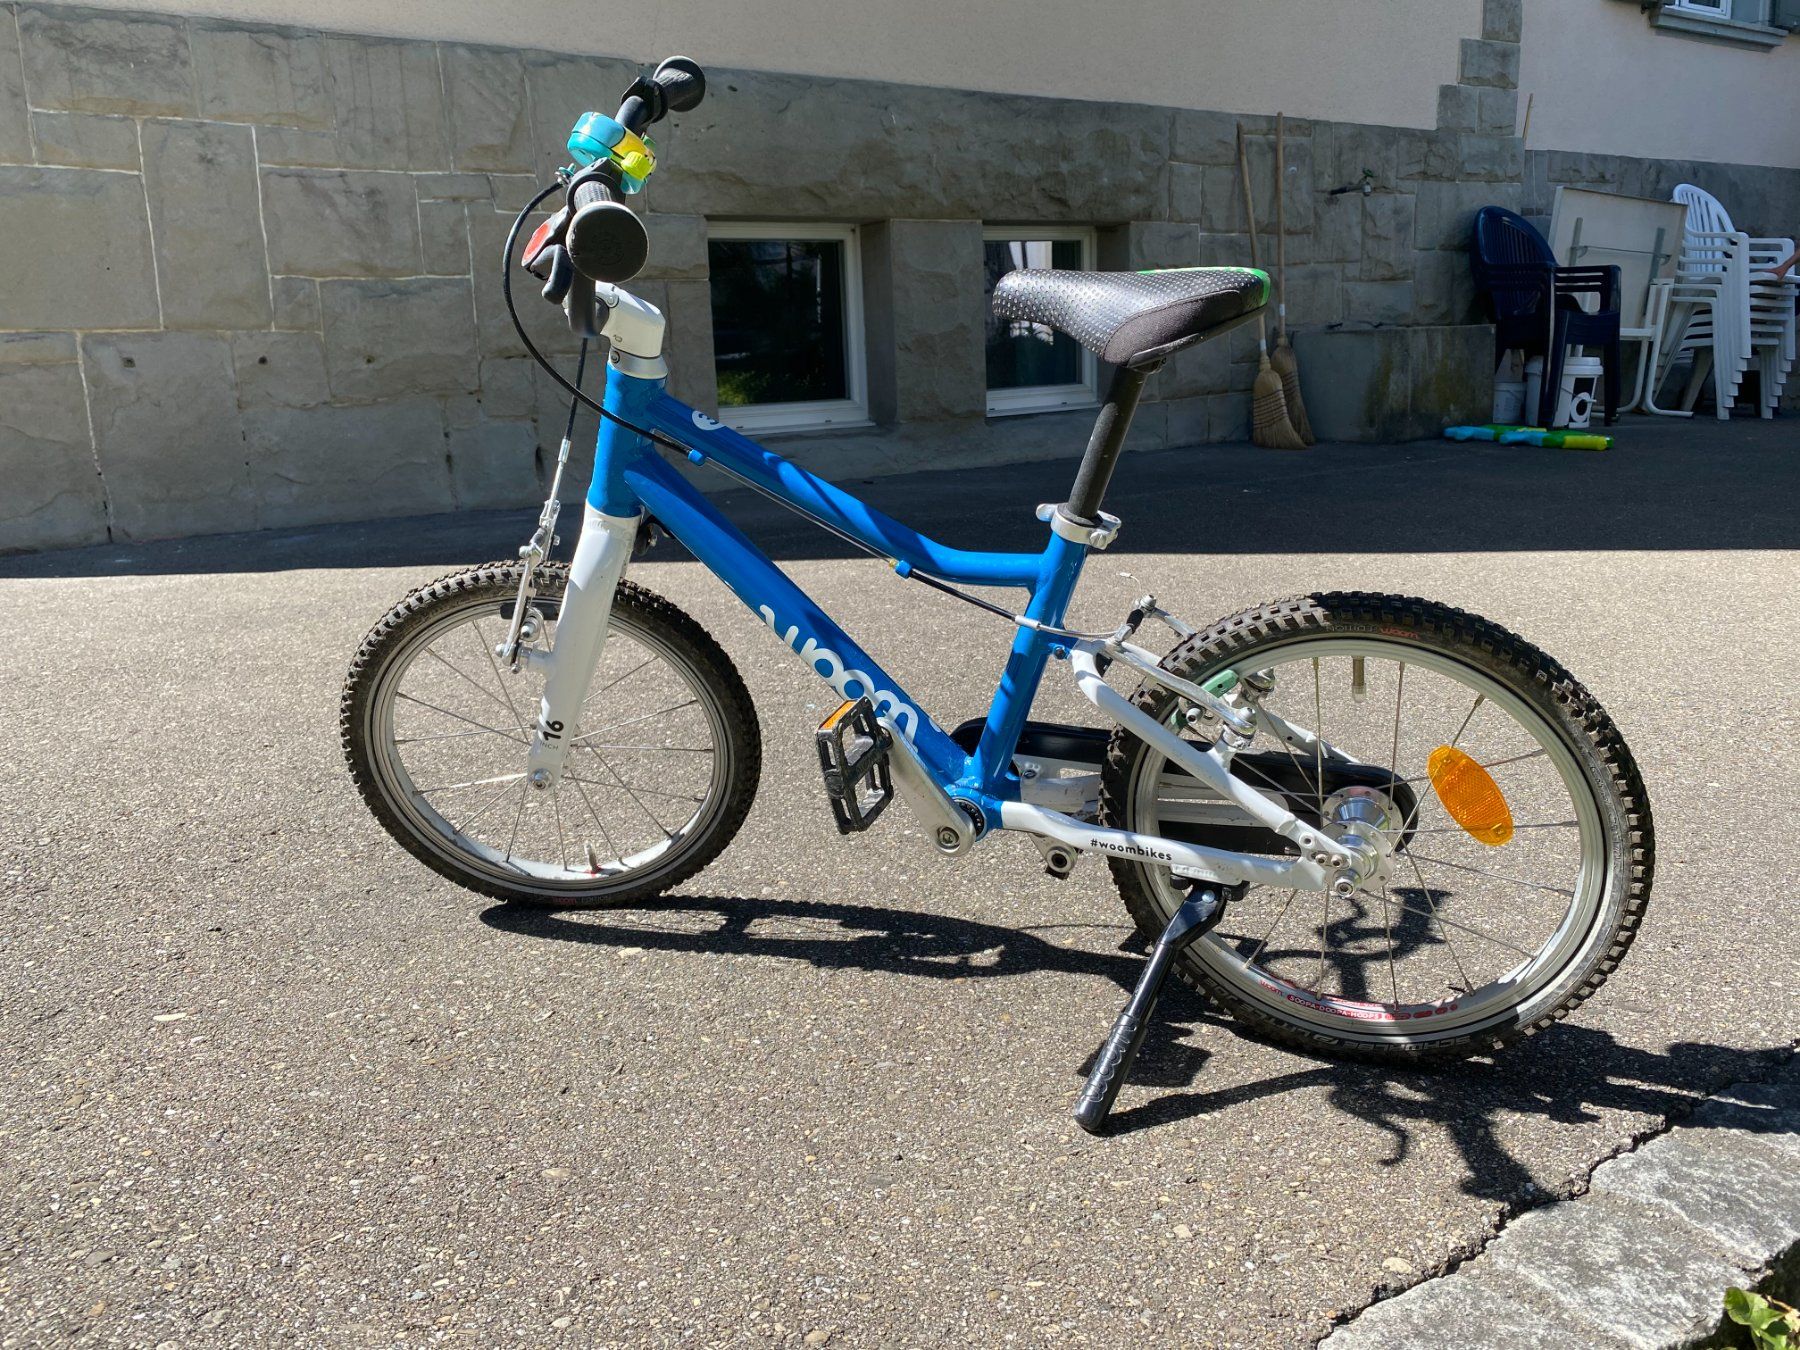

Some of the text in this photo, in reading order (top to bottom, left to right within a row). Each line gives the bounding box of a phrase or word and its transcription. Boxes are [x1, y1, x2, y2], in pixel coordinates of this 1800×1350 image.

[543, 720, 563, 741] 16
[540, 741, 559, 751] INCH
[1090, 838, 1172, 861] #woombikes
